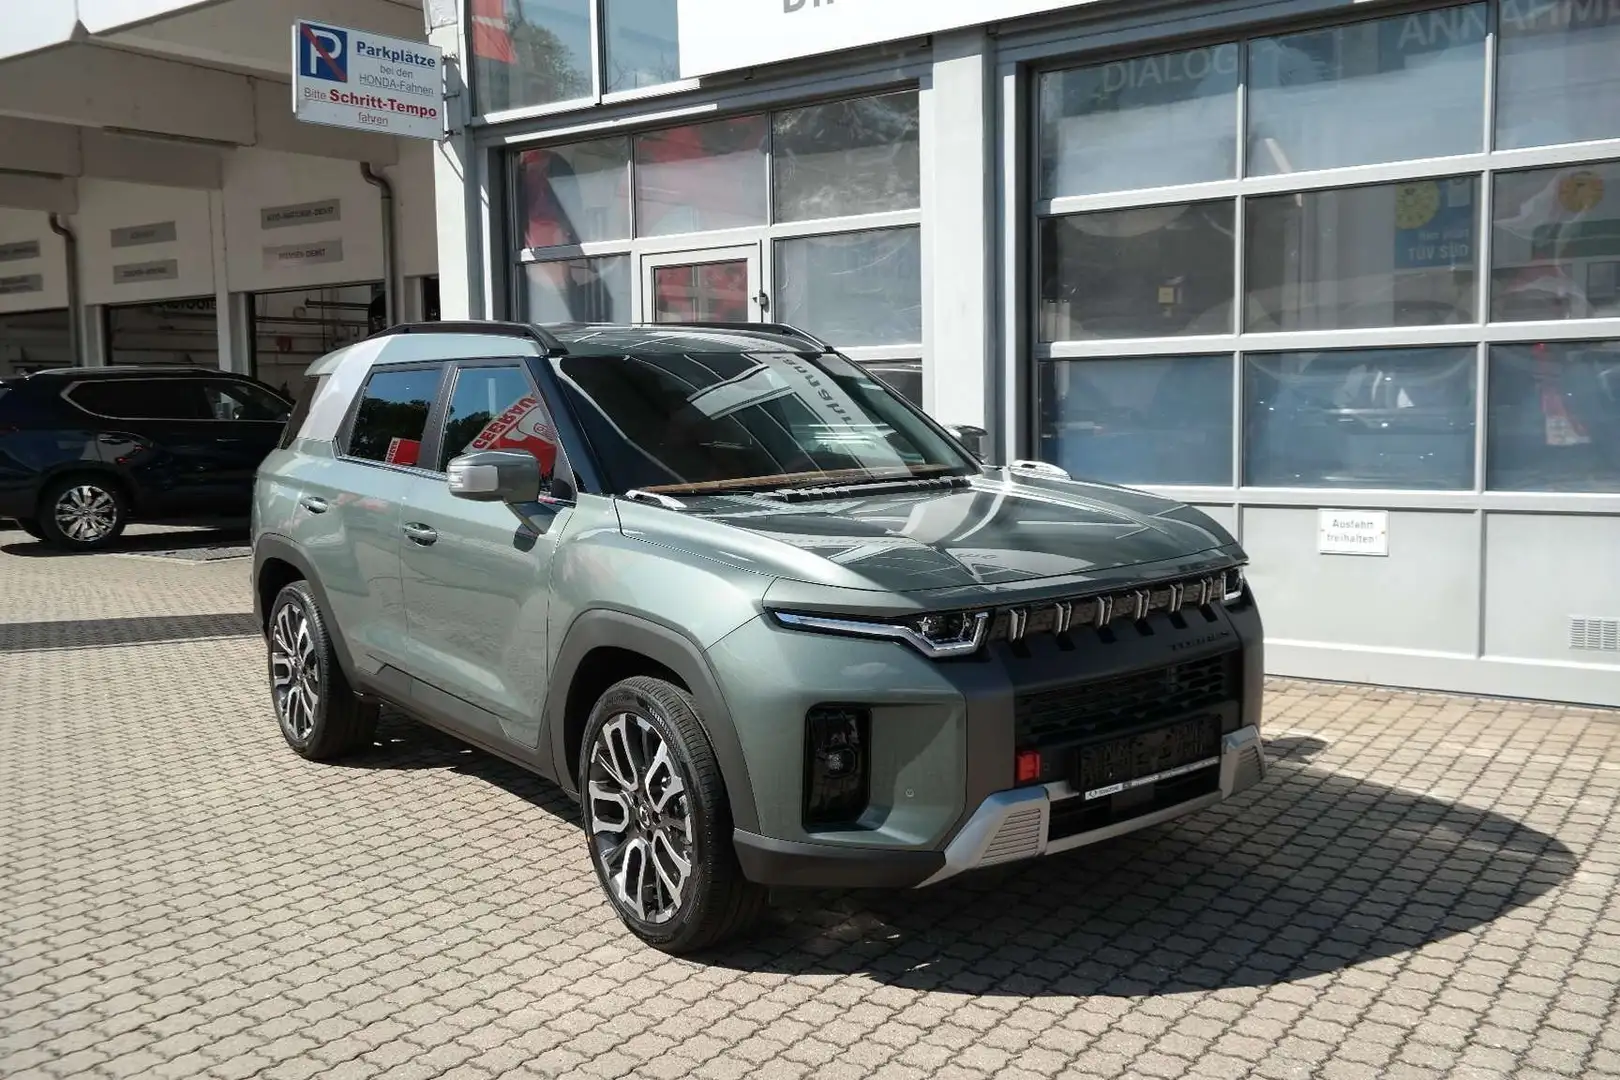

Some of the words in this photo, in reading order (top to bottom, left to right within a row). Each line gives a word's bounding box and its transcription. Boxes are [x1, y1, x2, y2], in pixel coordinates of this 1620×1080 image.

[356, 41, 436, 68] Parkplätze
[380, 65, 394, 76] bei
[396, 68, 413, 79] den
[1104, 42, 1239, 92] DIALOG
[359, 74, 434, 96] HONDA-Fahnen
[304, 87, 327, 100] Bitte
[330, 88, 437, 118] Schritt-Tempo
[358, 112, 388, 126] fahren
[1332, 519, 1374, 529] Ausfahrt
